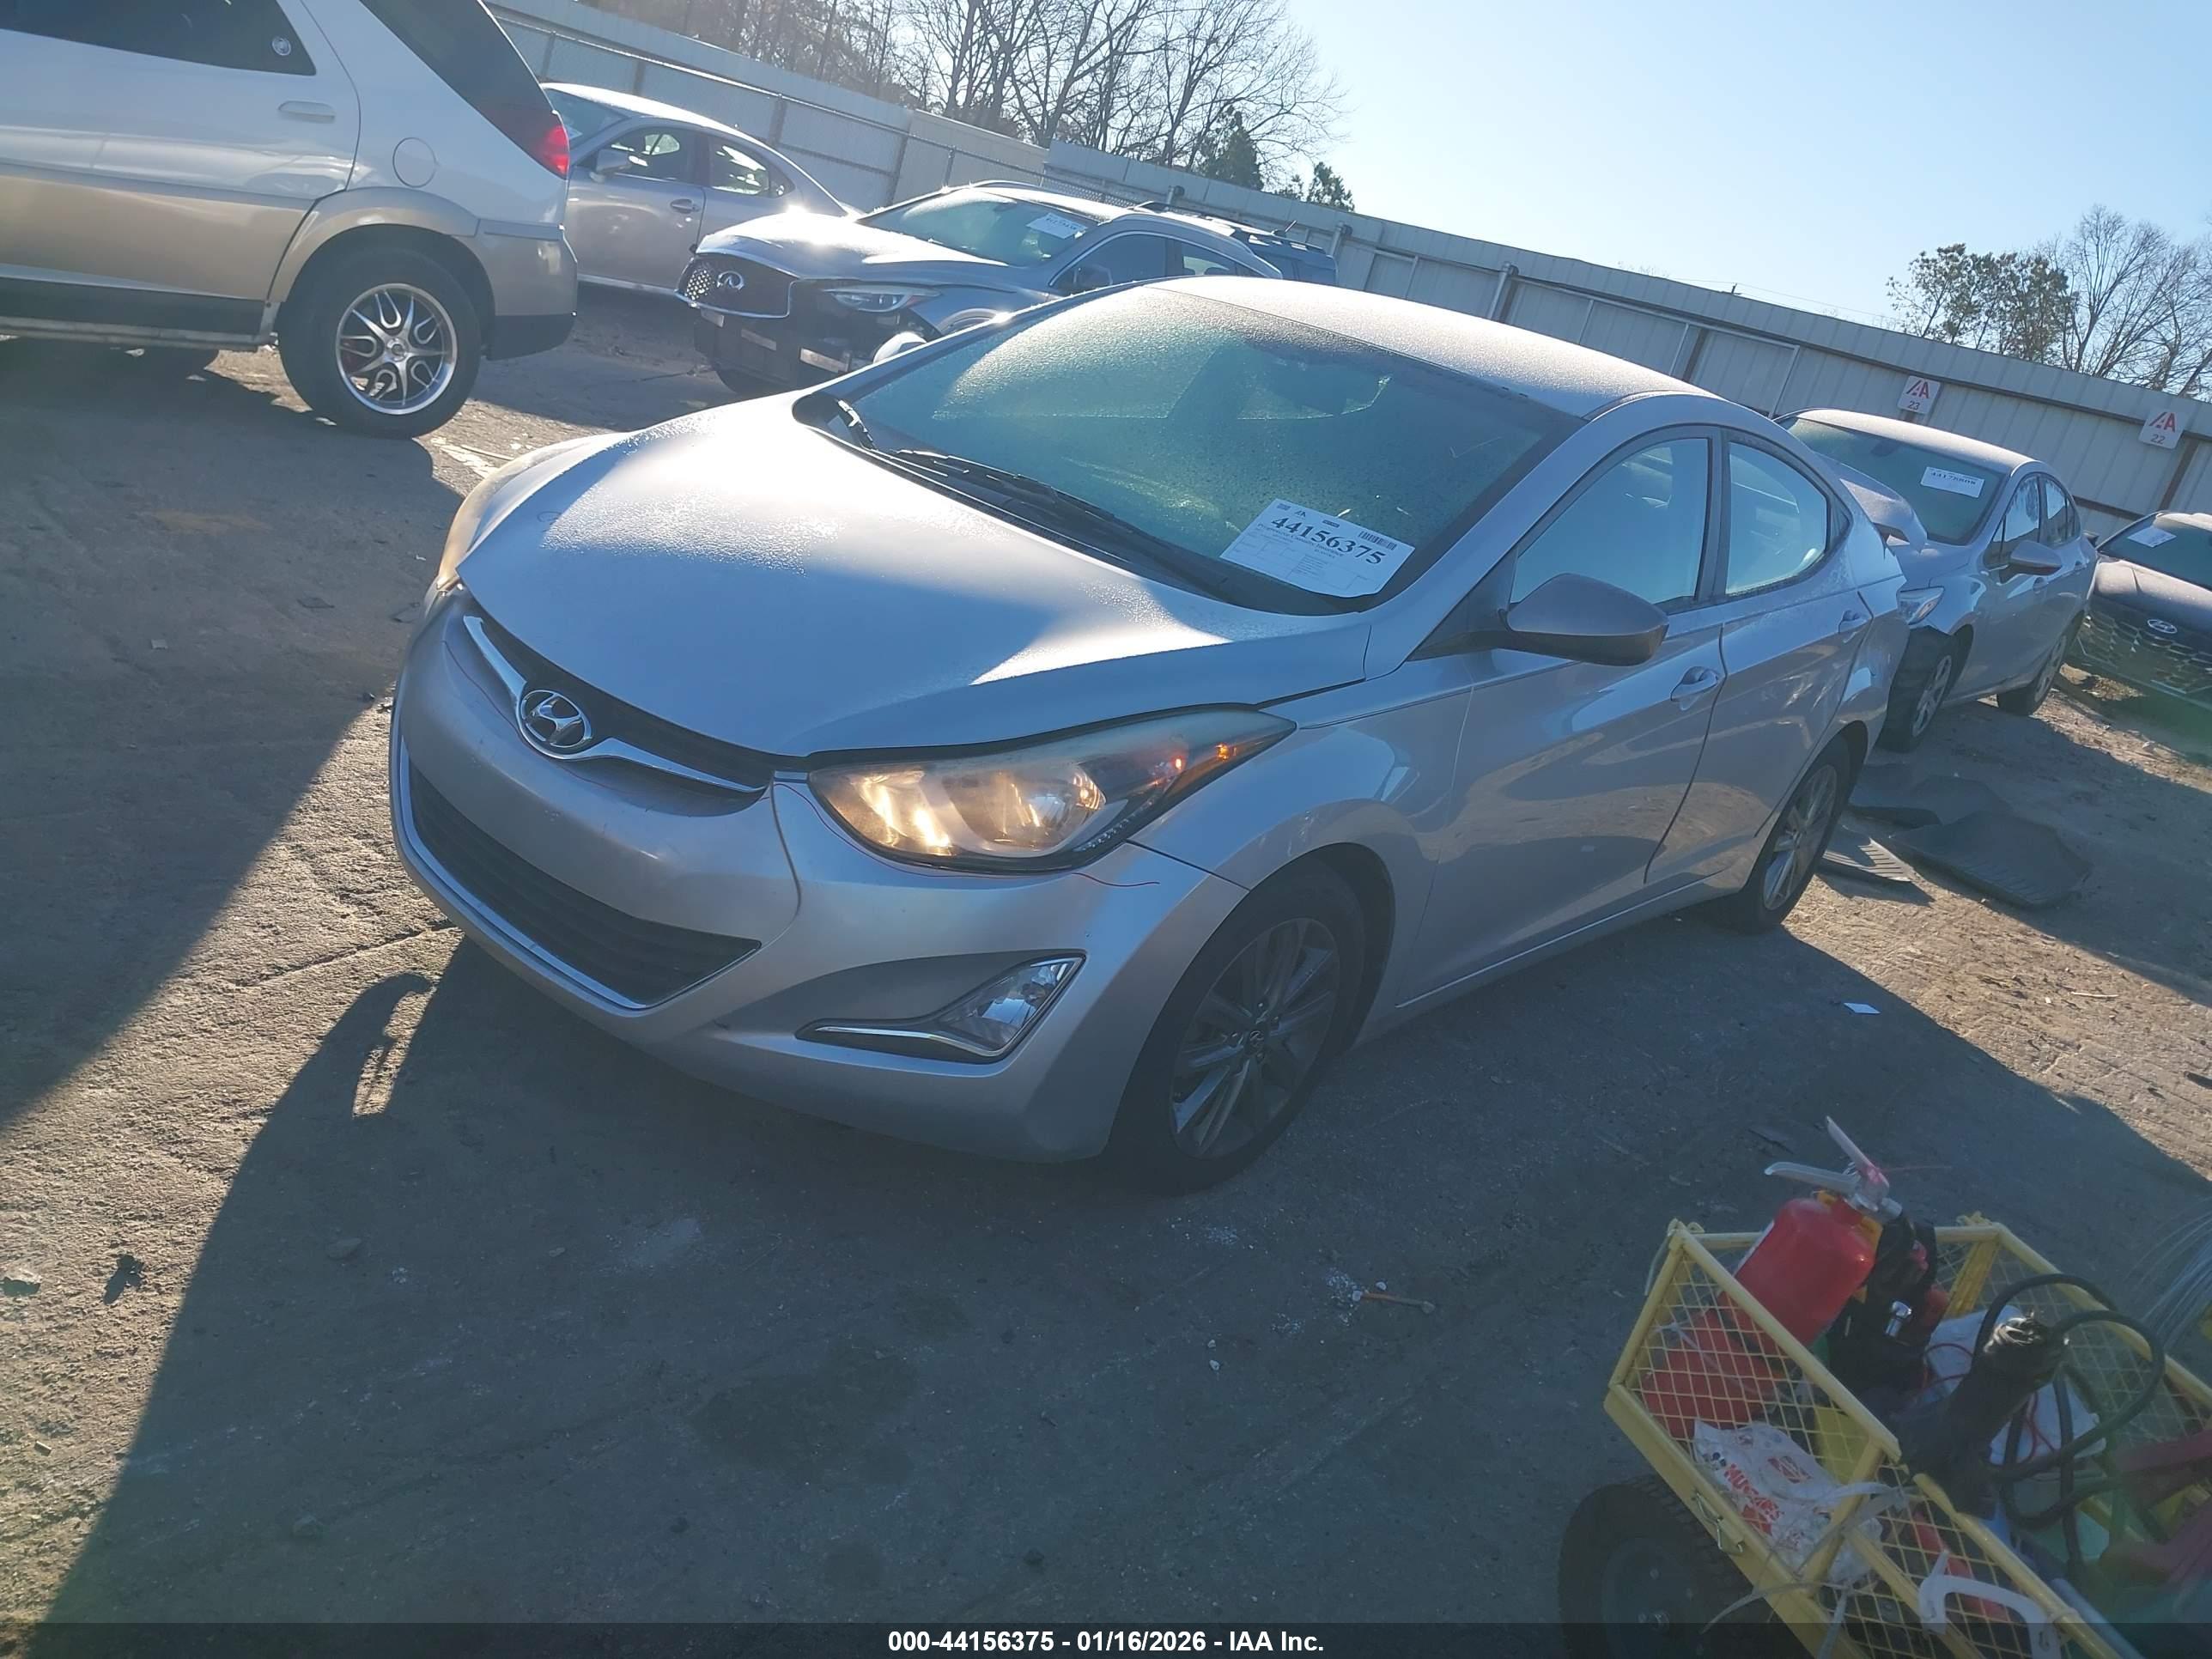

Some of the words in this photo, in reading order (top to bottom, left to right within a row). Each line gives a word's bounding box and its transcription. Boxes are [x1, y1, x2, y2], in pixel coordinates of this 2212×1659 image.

[1908, 400, 1920, 410] 23
[2150, 434, 2166, 445] 22
[1271, 517, 1387, 564] 44156375
